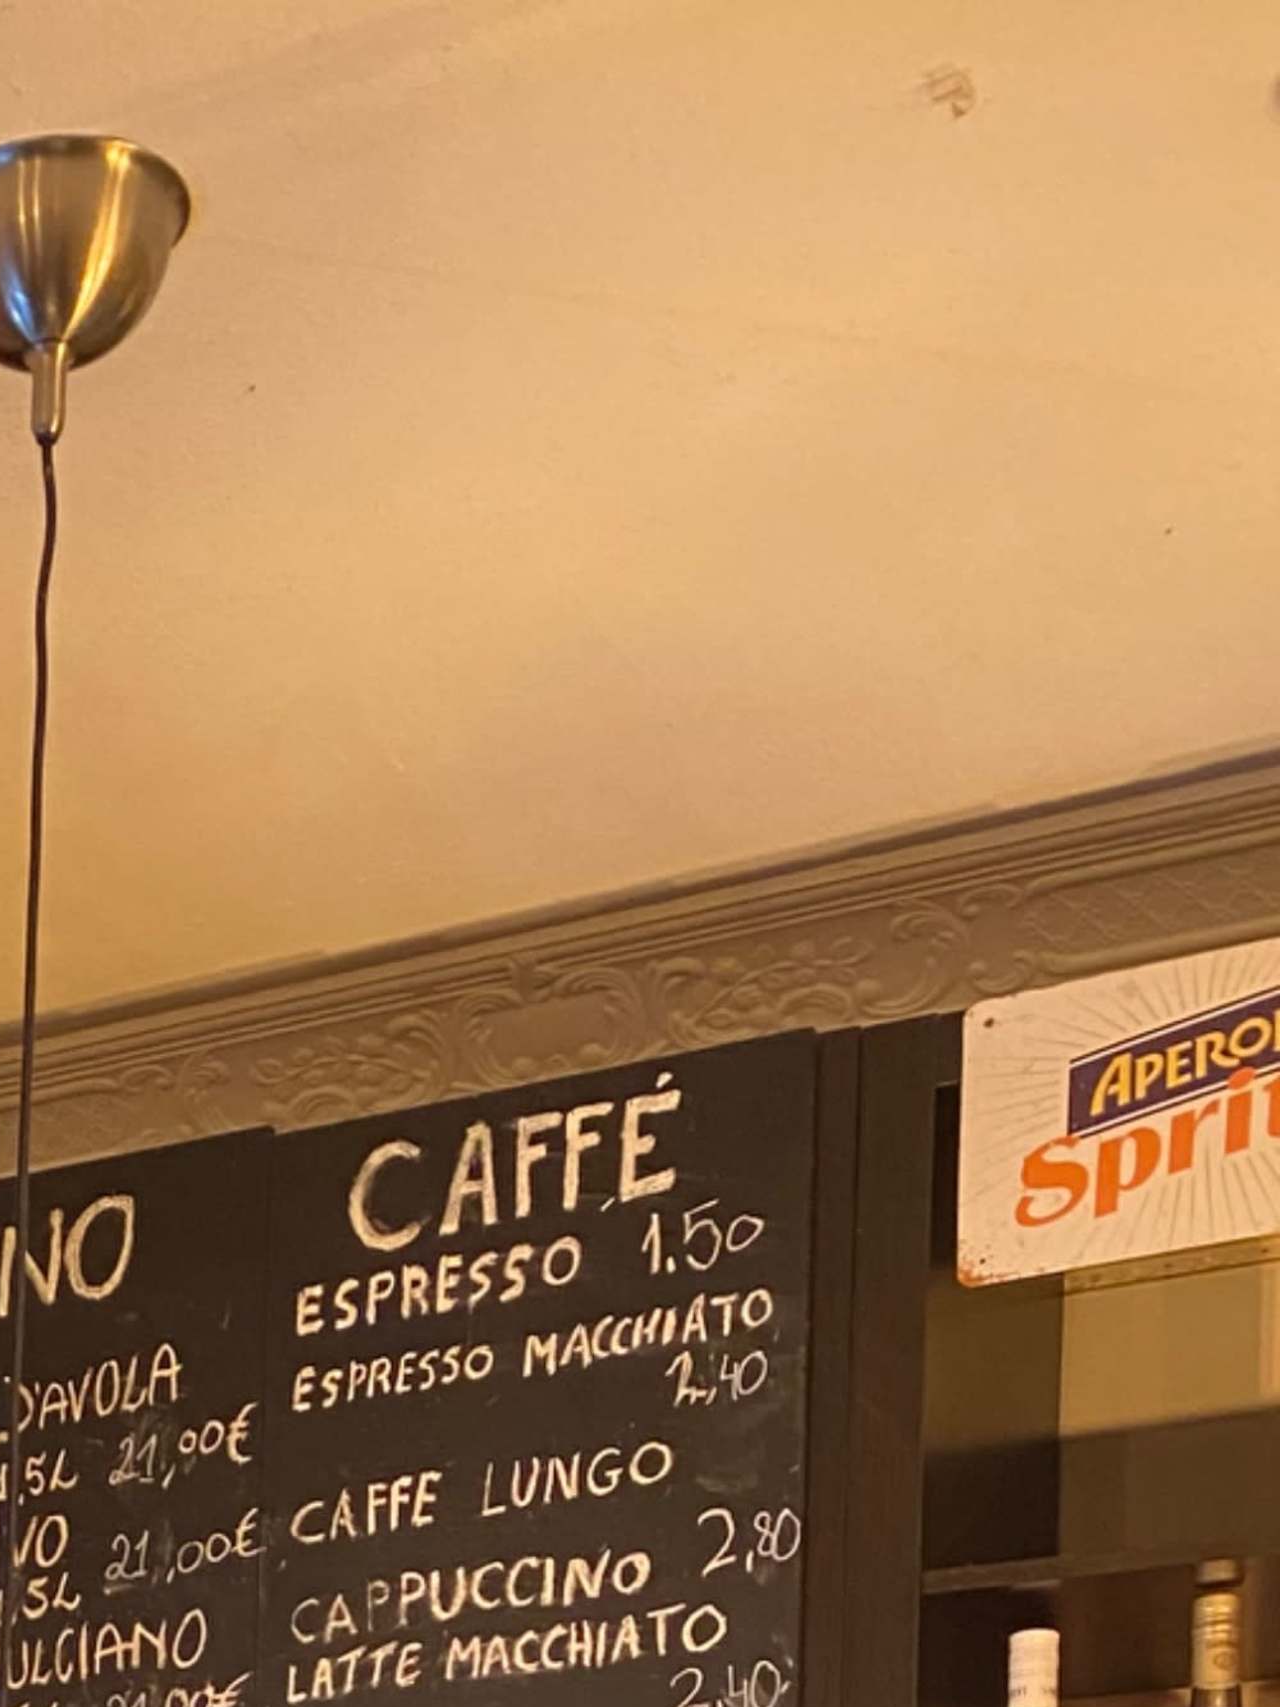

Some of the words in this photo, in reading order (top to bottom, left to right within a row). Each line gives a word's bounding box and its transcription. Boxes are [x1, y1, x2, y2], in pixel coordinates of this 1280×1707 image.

[348, 1072, 682, 1251] CAFFÉ
[296, 1236, 582, 1336] ESPRESSO
[293, 1345, 494, 1411] ESPRESSO
[523, 1288, 773, 1377] MACCHIATO
[291, 1470, 442, 1543] CAFFE
[482, 1441, 673, 1517] LUNGO
[698, 1508, 801, 1578] 2,80
[291, 1548, 651, 1645] CAPPUCCINO
[287, 1642, 422, 1703] LATTE
[445, 1603, 727, 1681] MACCHIATO
